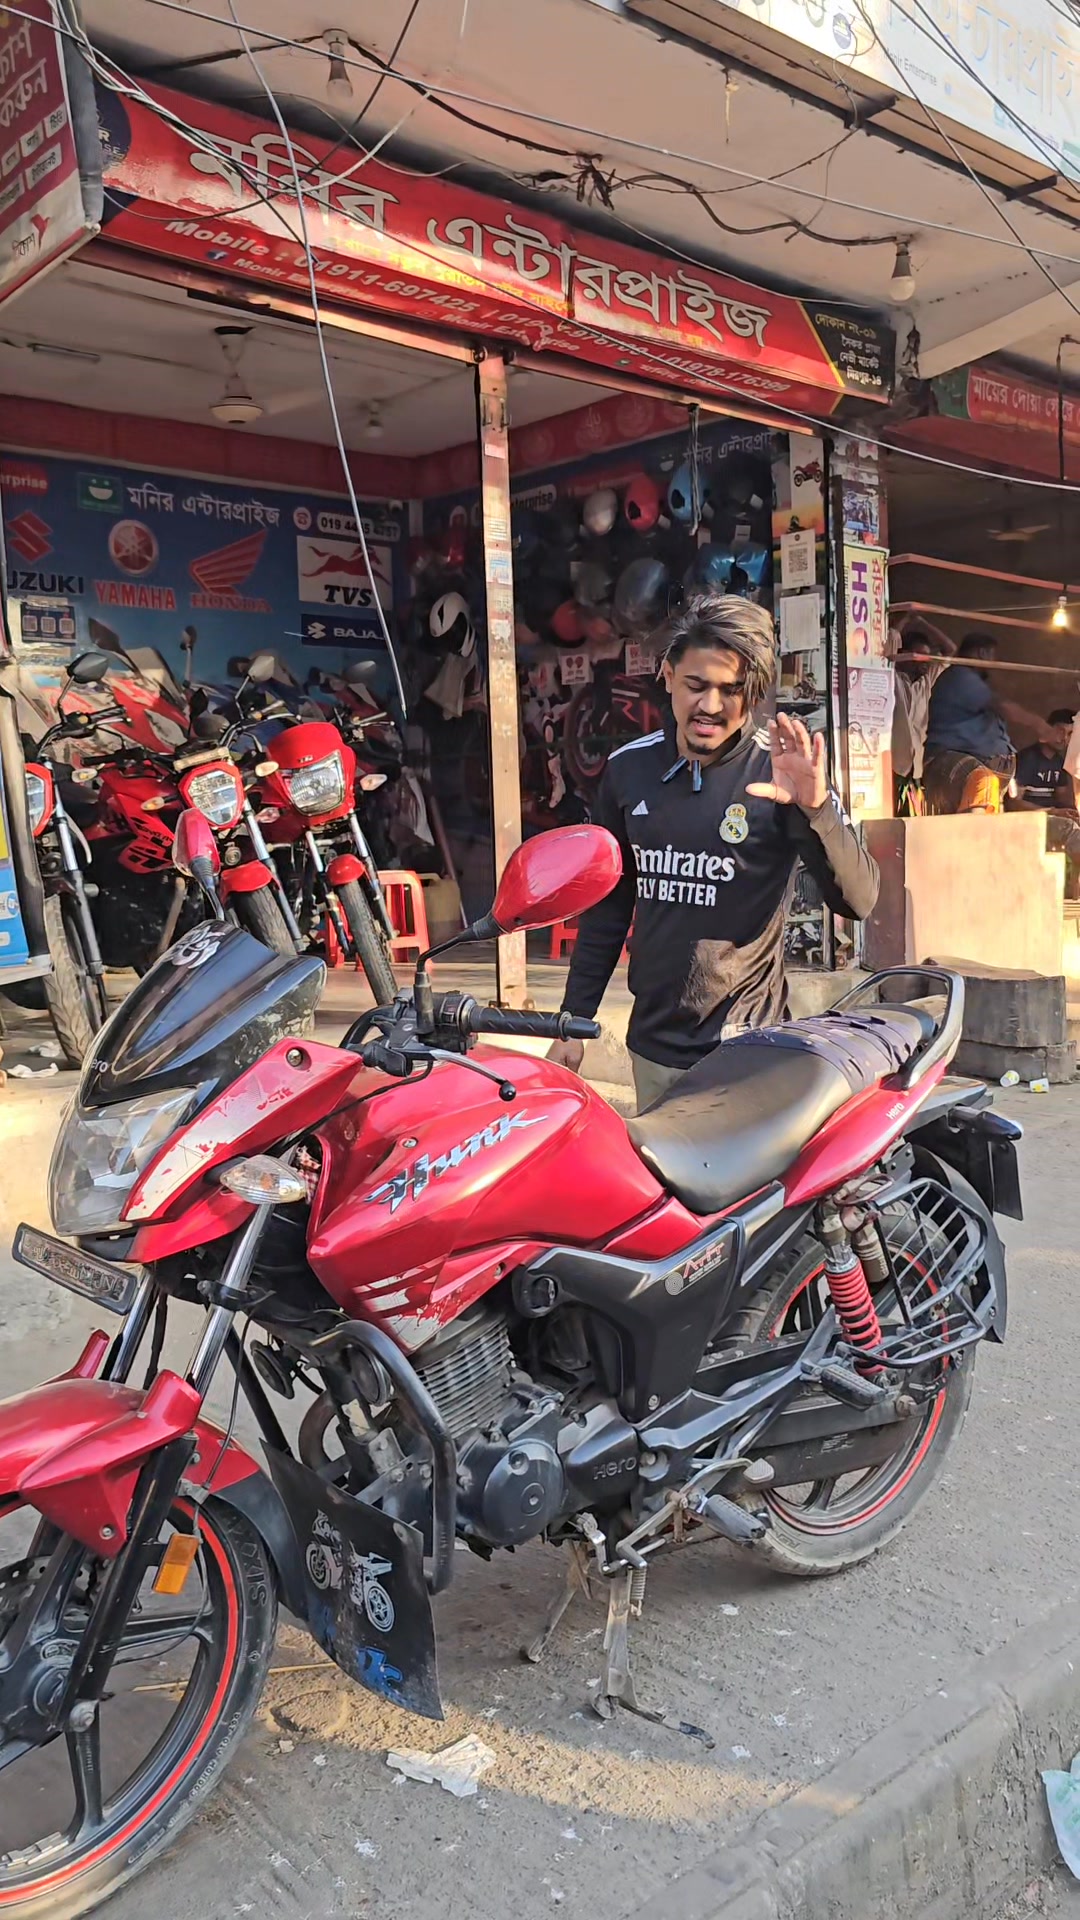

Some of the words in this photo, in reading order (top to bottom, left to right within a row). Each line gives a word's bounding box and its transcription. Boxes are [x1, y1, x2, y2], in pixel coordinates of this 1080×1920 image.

[165, 220, 270, 256] Mobile
[233, 257, 287, 279] Monir
[426, 214, 772, 348] এন্টারপ্রাইজ
[439, 312, 492, 332] Monir
[127, 482, 175, 513] মনির
[182, 492, 281, 527] এন্টারপ্রাইজ
[94, 580, 178, 611] YAMAHA
[189, 592, 274, 614] HONDA
[324, 584, 374, 607] TVS
[850, 561, 869, 656] HSC
[631, 843, 735, 882] Emirates
[636, 877, 656, 899] FLY
[658, 879, 717, 907] BETTER
[886, 1102, 905, 1120] Hero
[364, 1108, 549, 1214] Hunk
[593, 1456, 637, 1480] Hero
